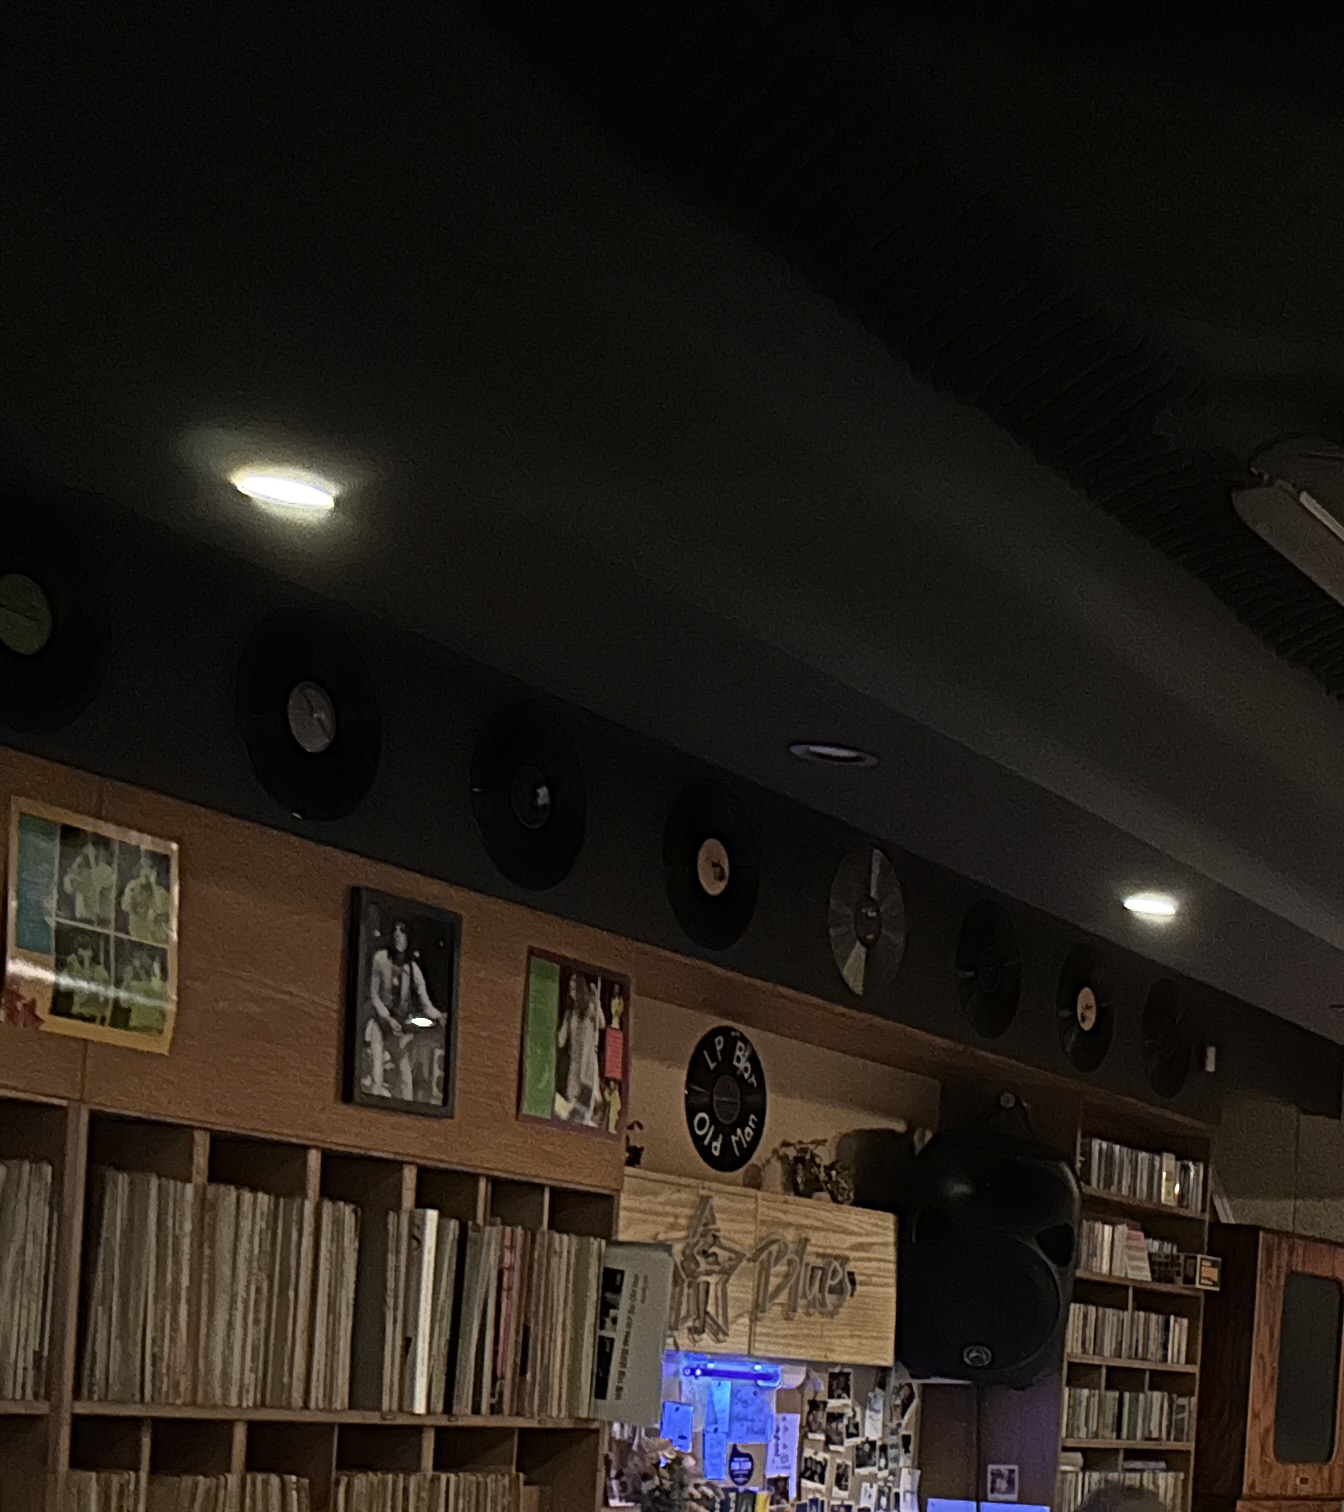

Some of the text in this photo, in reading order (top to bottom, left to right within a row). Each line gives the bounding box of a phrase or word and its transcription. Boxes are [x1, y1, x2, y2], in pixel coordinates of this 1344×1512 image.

[703, 1035, 724, 1070] LP
[693, 1111, 758, 1157] Old Man
[747, 1237, 857, 1320] Blues
